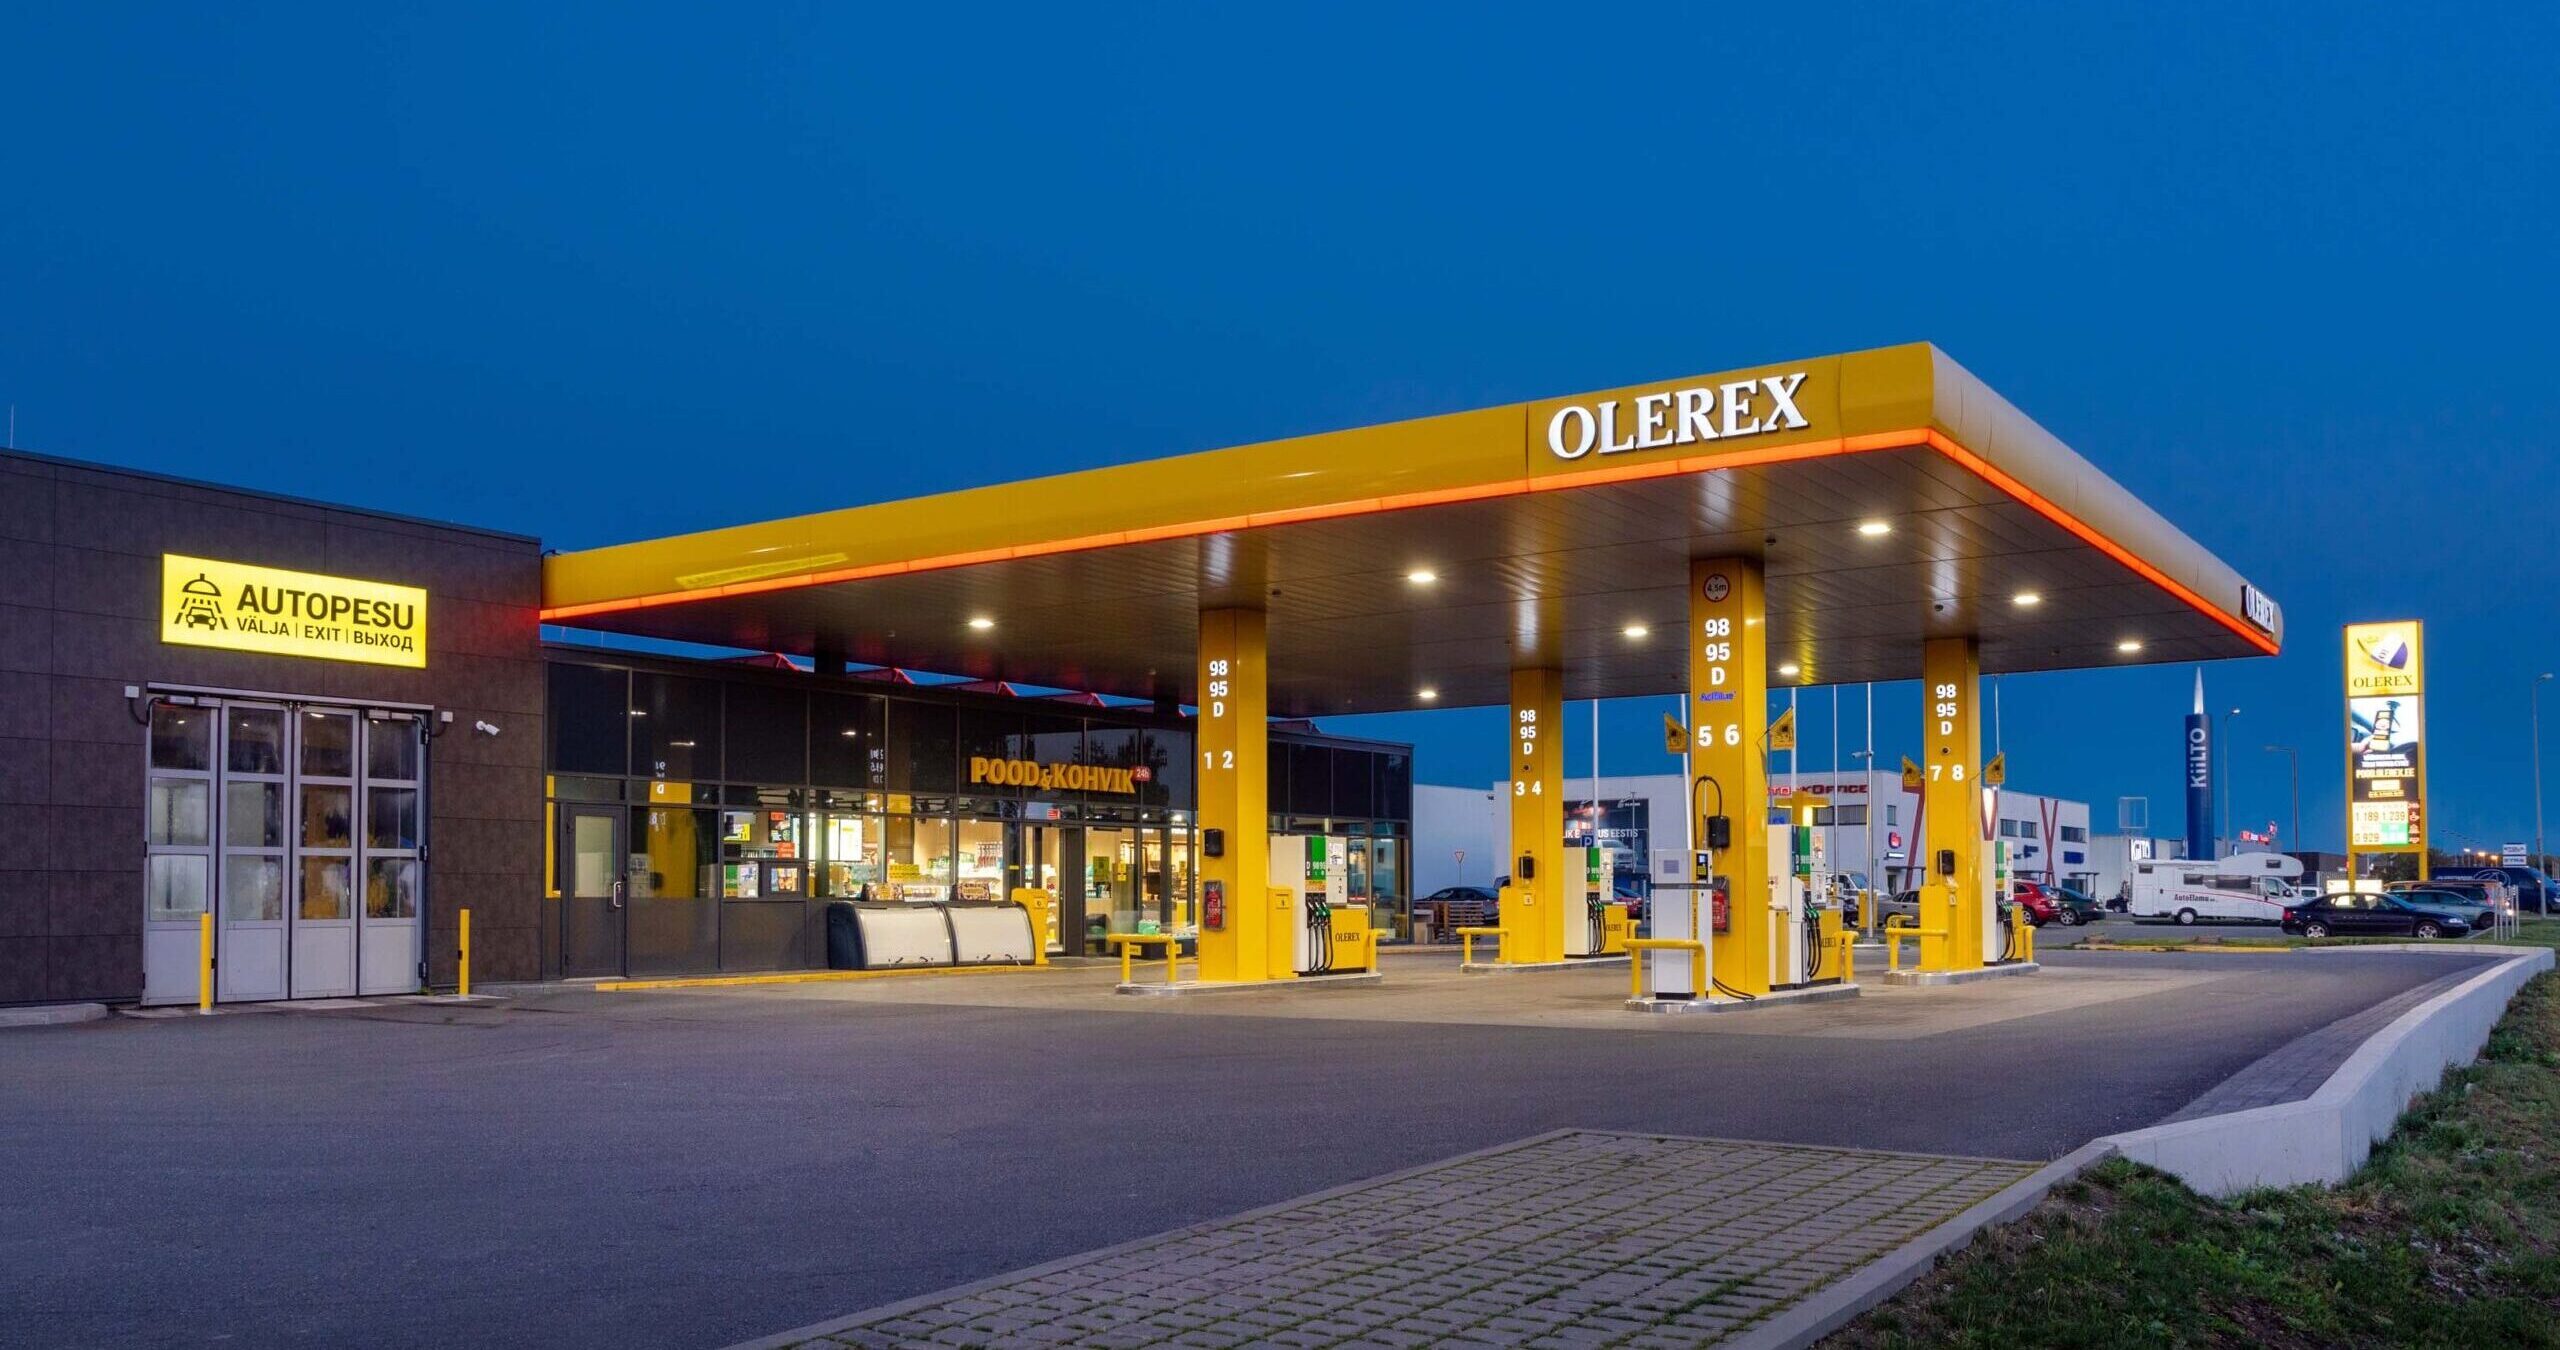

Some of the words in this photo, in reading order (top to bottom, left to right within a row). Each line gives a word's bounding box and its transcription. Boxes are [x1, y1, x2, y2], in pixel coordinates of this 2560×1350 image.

[1548, 372, 1809, 459] OLEREX
[237, 584, 414, 630] AUTOPESU
[2246, 584, 2275, 632] OLEREX
[237, 615, 290, 636] VÄLJA
[304, 625, 341, 642] EXIT
[354, 631, 413, 652] ВЫХОД
[1705, 618, 1730, 637] 98
[1705, 643, 1731, 662] 95
[1209, 660, 1228, 676] 98
[1711, 667, 1725, 685] D
[1209, 681, 1228, 697] 95
[2353, 675, 2413, 688] OLEREX
[1936, 684, 1957, 699] 98
[1213, 701, 1224, 717] D
[1520, 709, 1536, 723] 98
[1936, 702, 1957, 717] 95
[1520, 726, 1536, 739] 95
[1698, 726, 1713, 747] 5
[1725, 724, 1740, 746] 6
[1941, 721, 1953, 735] D
[1523, 742, 1533, 755] D
[1204, 752, 1213, 770] 1
[1222, 751, 1233, 769] 2
[971, 756, 1135, 793] POOD&KOHVIK
[1930, 765, 1943, 782] 7
[1952, 764, 1964, 781] 8
[1515, 781, 1525, 796] 3
[1532, 781, 1542, 796] 4
[1584, 837, 1592, 846] P
[1611, 829, 1638, 838] EESTIS
